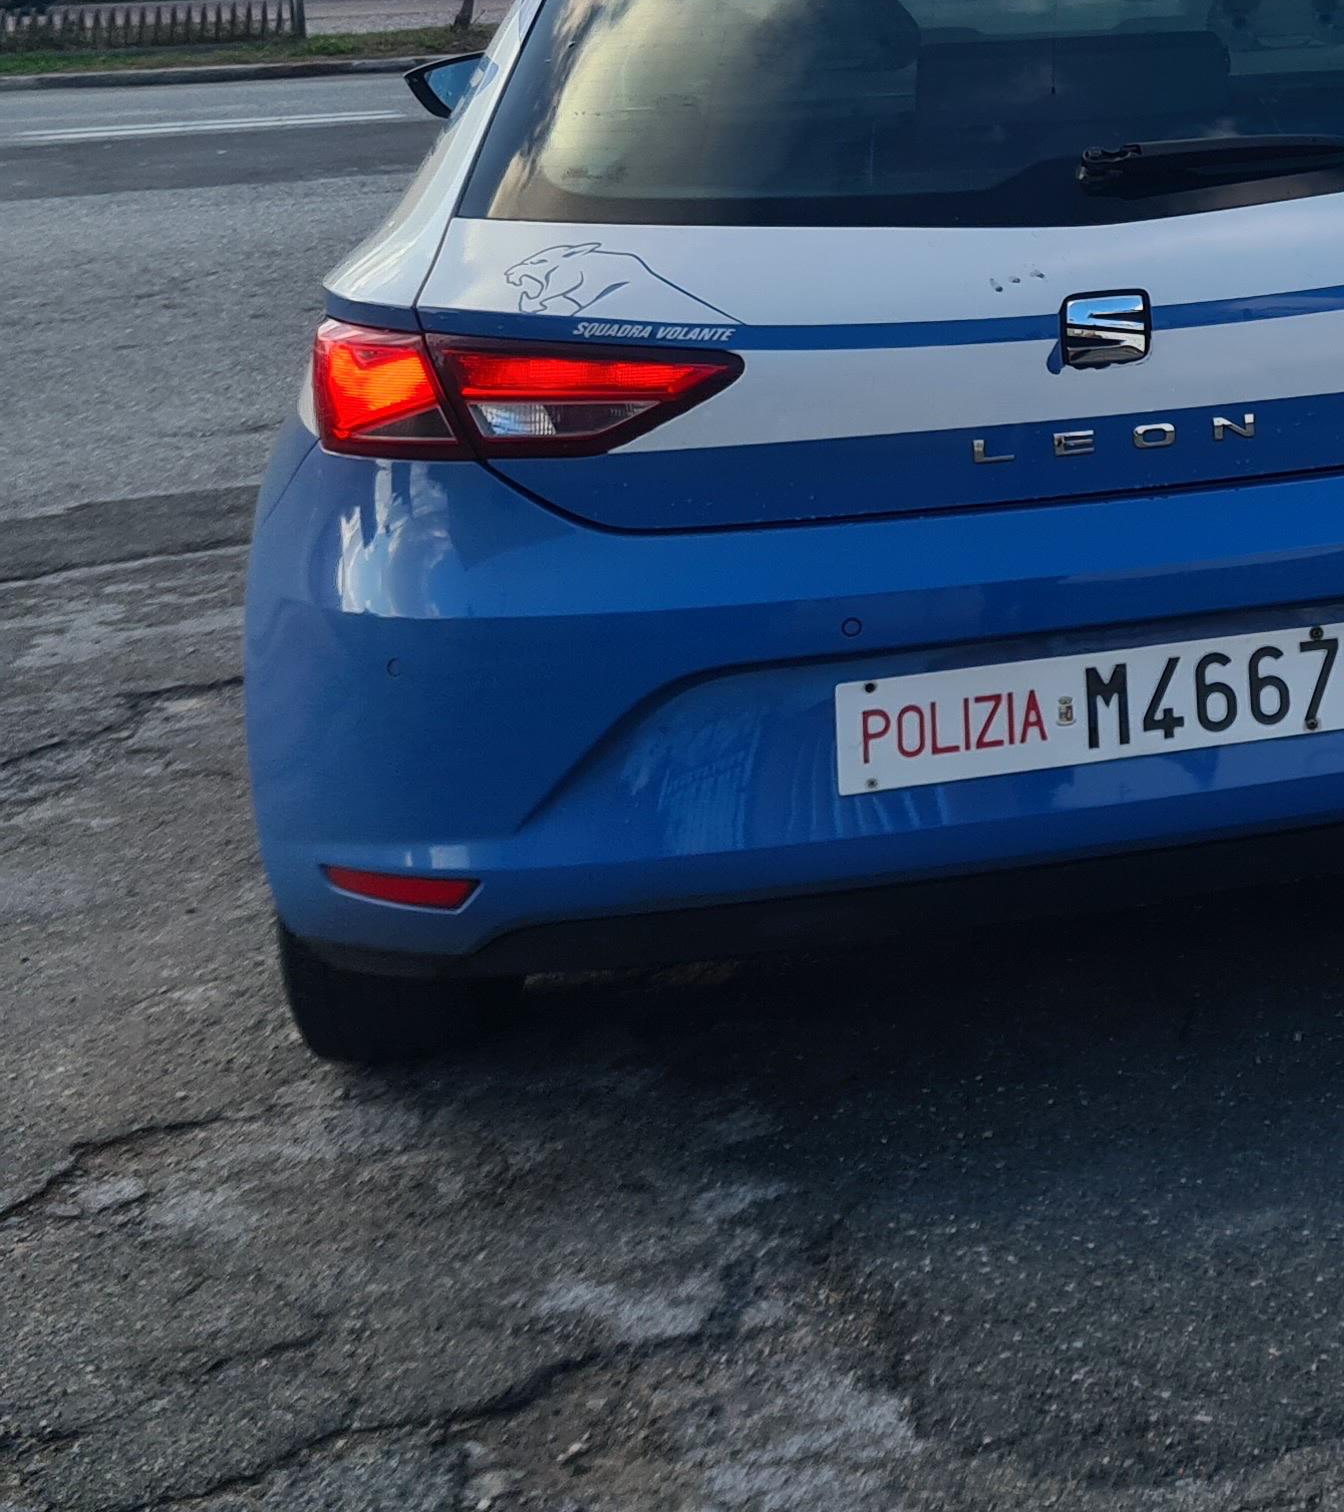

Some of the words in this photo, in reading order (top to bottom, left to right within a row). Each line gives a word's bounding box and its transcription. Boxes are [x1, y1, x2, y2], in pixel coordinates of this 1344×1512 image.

[572, 321, 652, 339] SQUADRA
[656, 325, 736, 341] VOLANTE
[972, 412, 1256, 464] LEON
[861, 689, 1049, 765] POLIZIA
[1085, 637, 1340, 750] M4667
